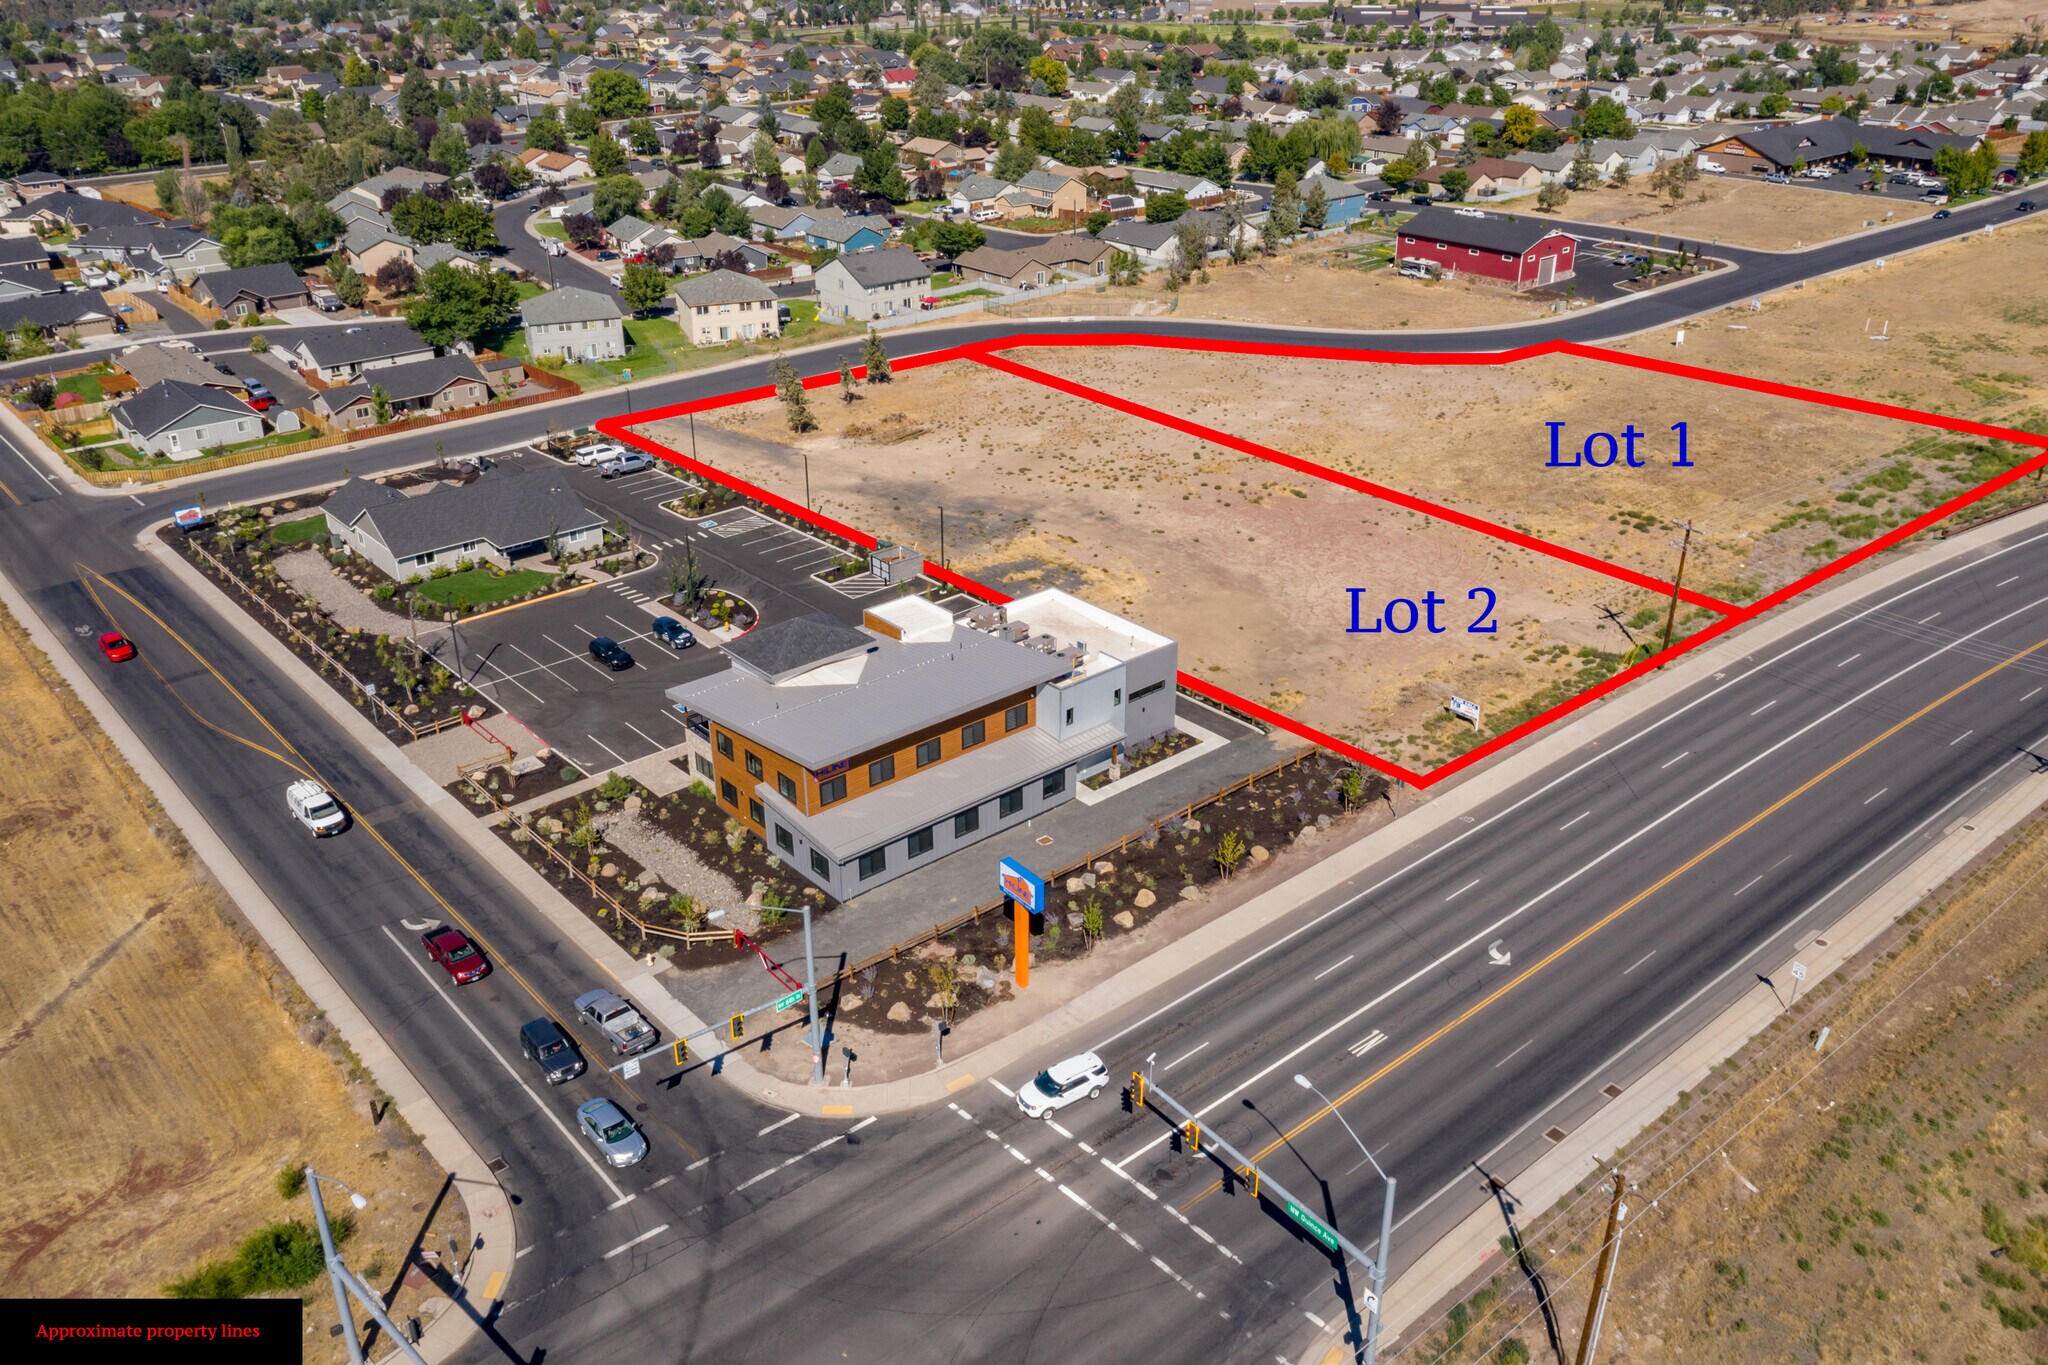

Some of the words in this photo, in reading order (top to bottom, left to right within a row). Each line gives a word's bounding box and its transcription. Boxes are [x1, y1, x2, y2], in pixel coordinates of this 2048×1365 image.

[785, 997, 795, 1006] 6th
[1290, 1205, 1300, 1217] NW
[1300, 1214, 1322, 1235] Quince
[1322, 1231, 1335, 1245] Ave
